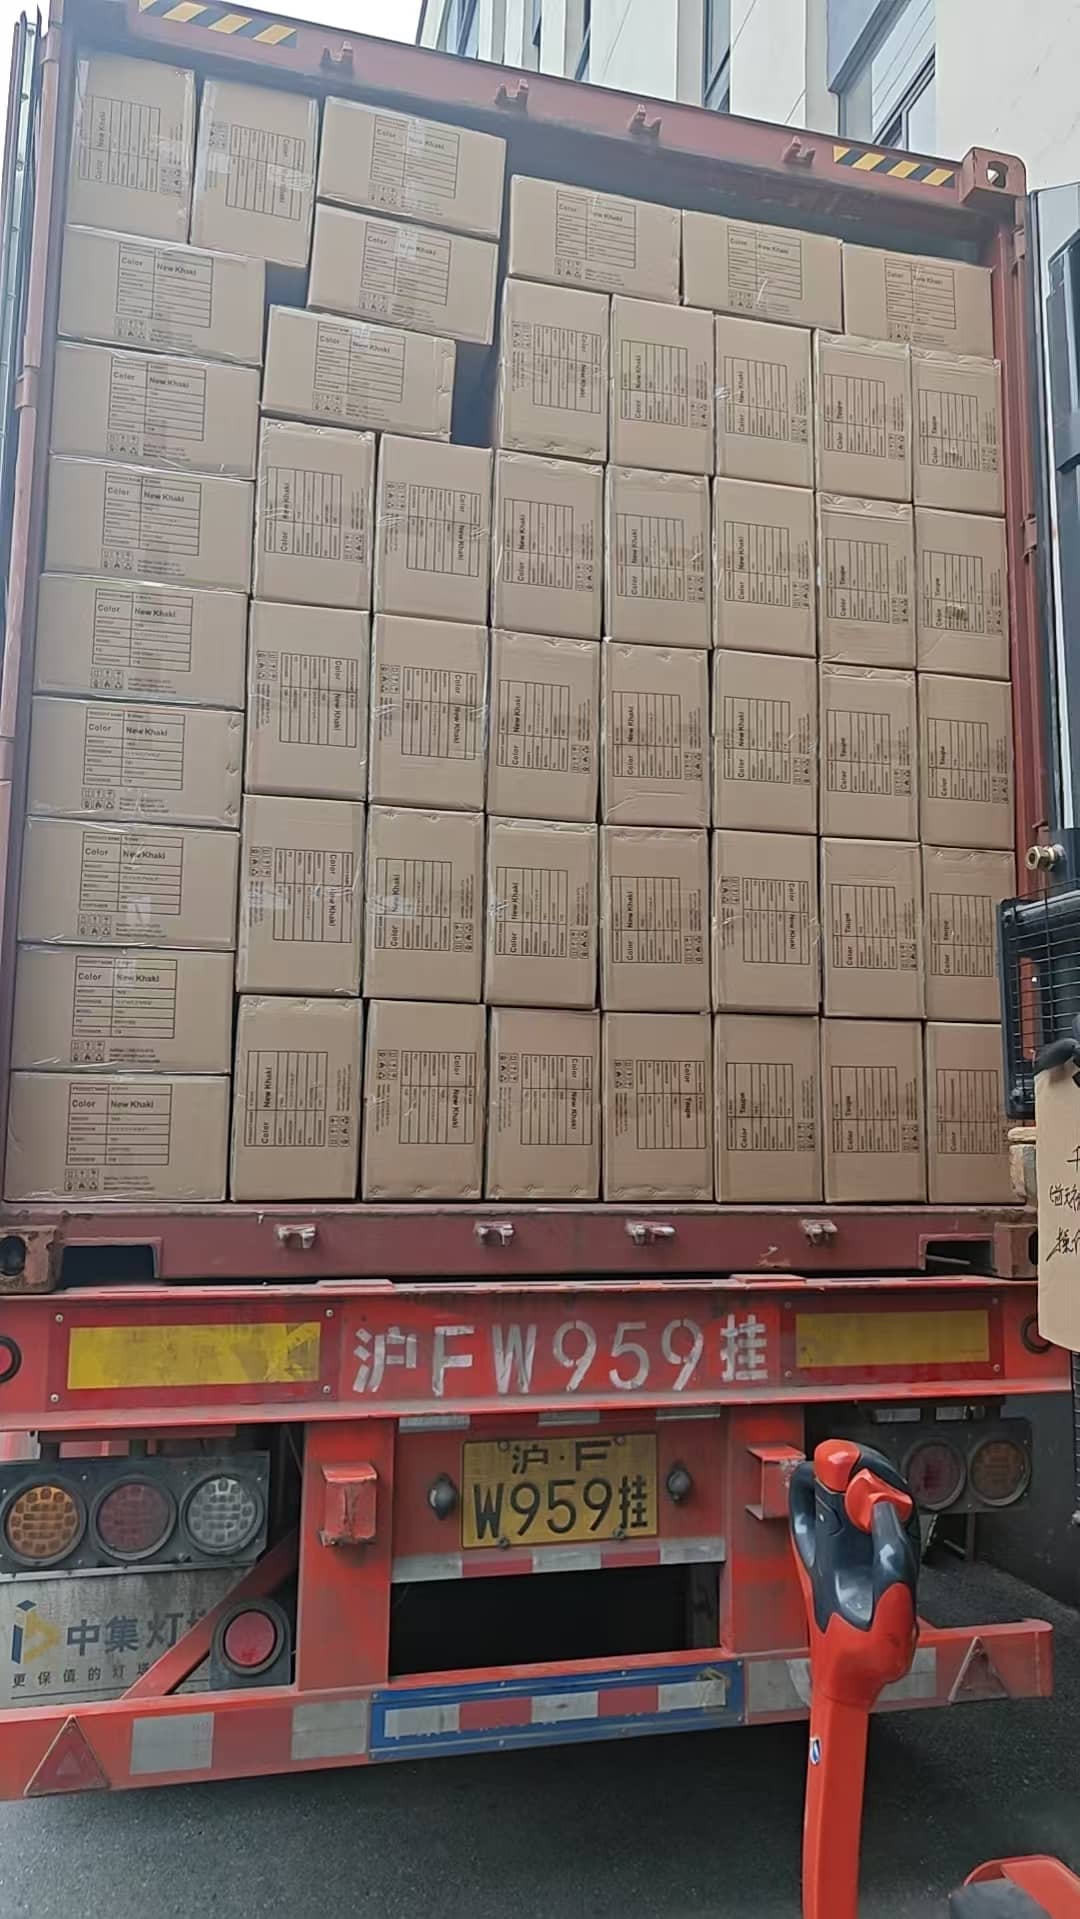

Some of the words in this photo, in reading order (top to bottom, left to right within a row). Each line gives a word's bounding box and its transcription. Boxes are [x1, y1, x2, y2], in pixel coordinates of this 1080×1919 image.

[114, 371, 135, 380] Color
[108, 487, 129, 496] Color
[162, 494, 184, 502] Khaki
[98, 604, 120, 612] Color
[135, 607, 151, 616] New
[153, 609, 176, 618] Khaki
[454, 674, 462, 694] Color
[89, 723, 111, 732] Color
[145, 728, 168, 737] Khaki
[85, 848, 108, 856] Color
[142, 851, 166, 860] Khaki
[136, 975, 159, 983] Khaki
[264, 1067, 272, 1088] Khaki
[264, 1090, 272, 1108] New
[72, 1100, 95, 1108] Color
[261, 1122, 269, 1144] Color
[353, 1314, 768, 1397] 沪FW959挂
[473, 1474, 648, 1539] W959挂
